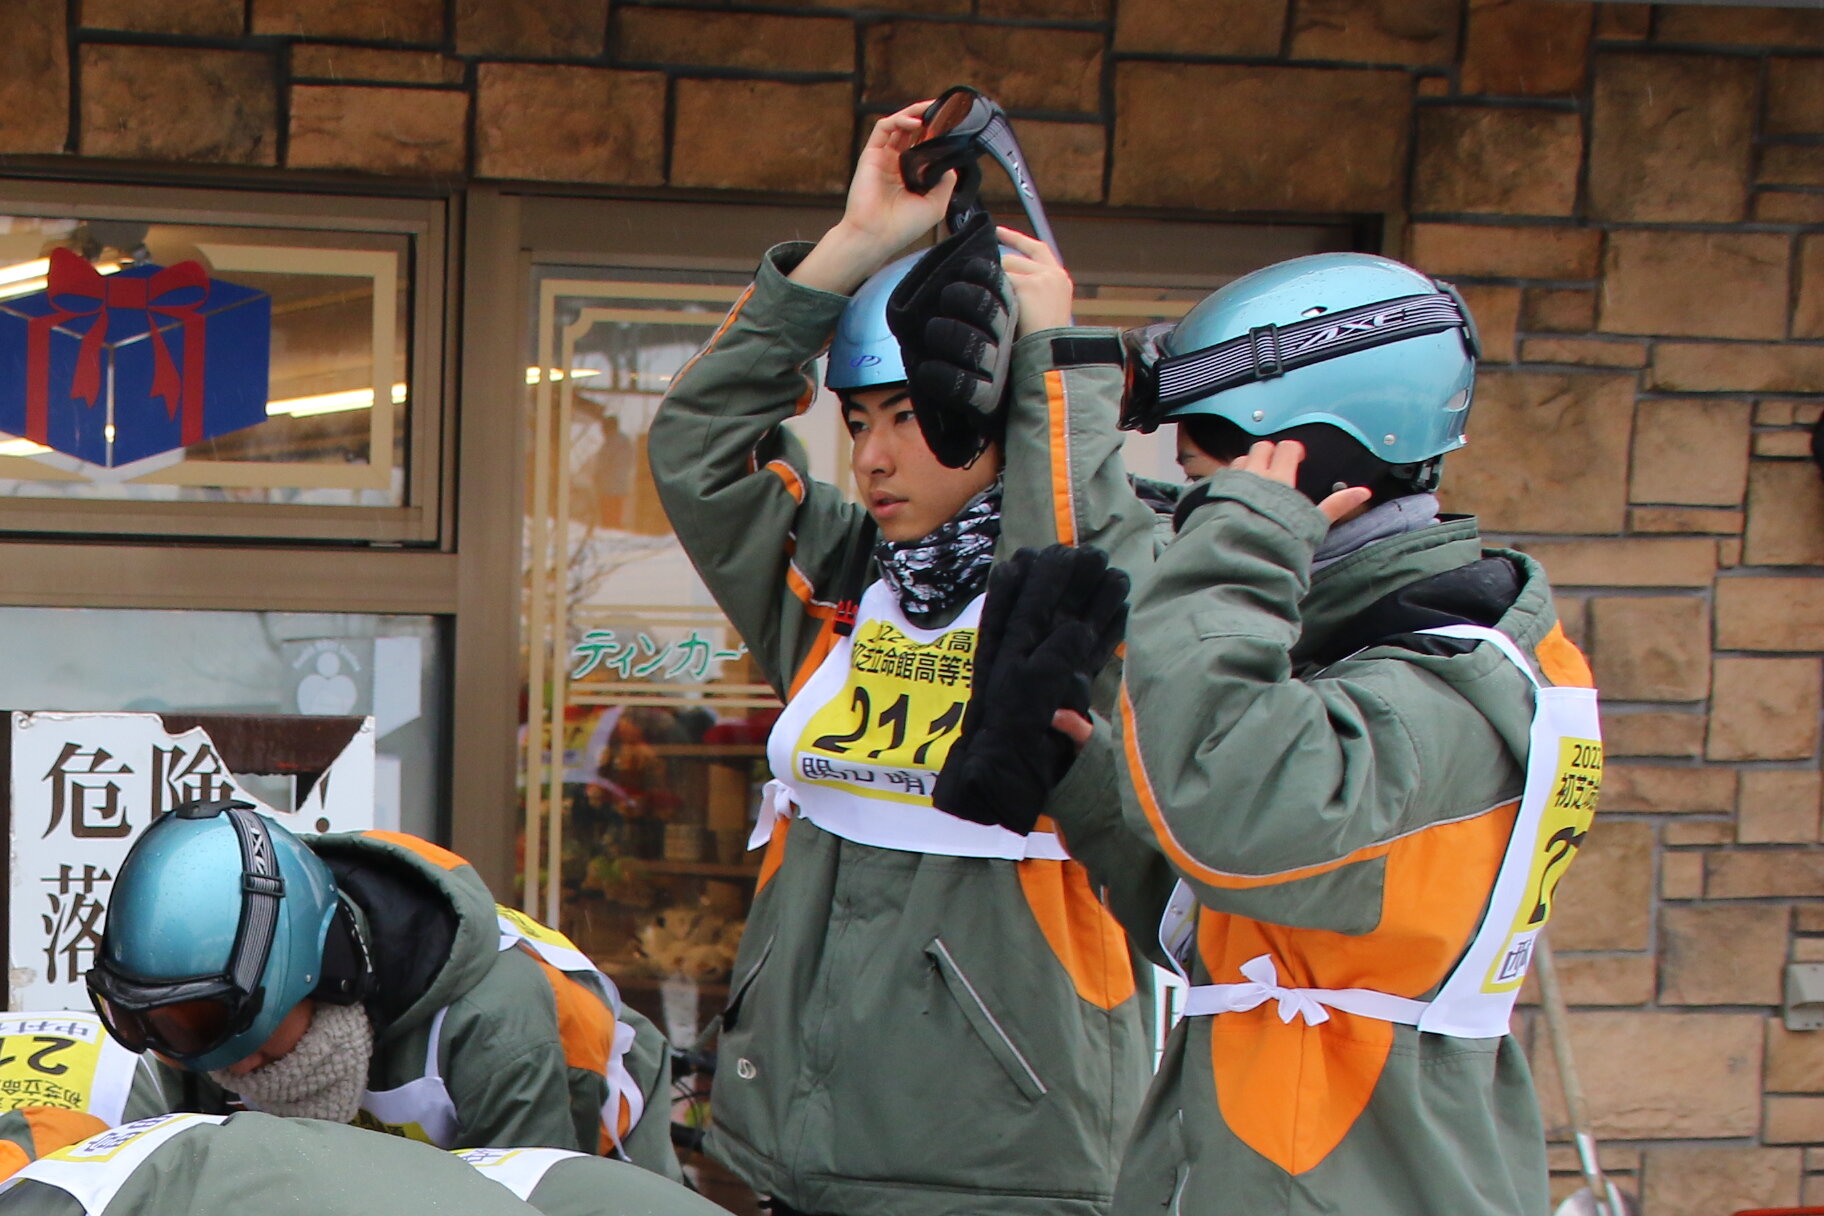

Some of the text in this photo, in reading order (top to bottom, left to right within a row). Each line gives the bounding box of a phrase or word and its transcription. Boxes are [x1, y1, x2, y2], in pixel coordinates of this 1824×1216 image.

[573, 630, 747, 681] ティンカー
